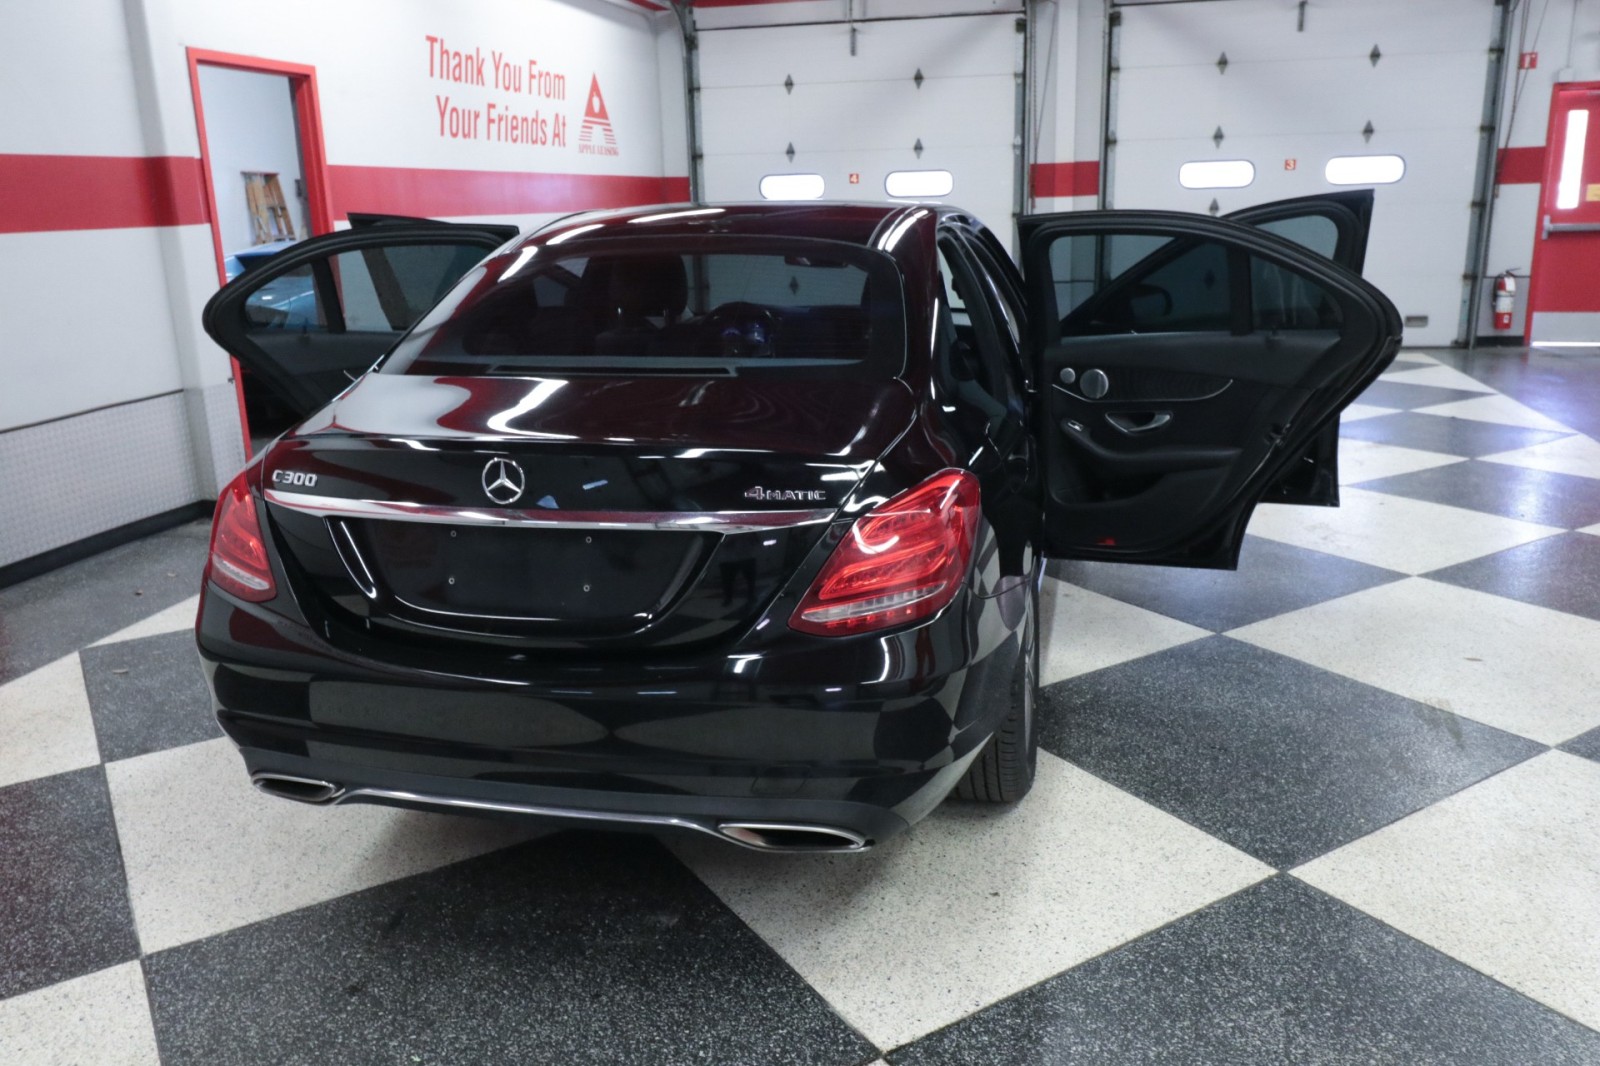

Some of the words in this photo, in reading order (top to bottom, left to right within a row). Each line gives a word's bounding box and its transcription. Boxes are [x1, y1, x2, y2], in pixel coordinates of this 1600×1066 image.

[425, 35, 485, 87] Thank
[492, 51, 522, 93] You
[529, 59, 566, 101] From
[436, 95, 480, 140] Your
[487, 103, 547, 146] Friends
[552, 112, 566, 148] At
[744, 486, 826, 500] 4MATIC
